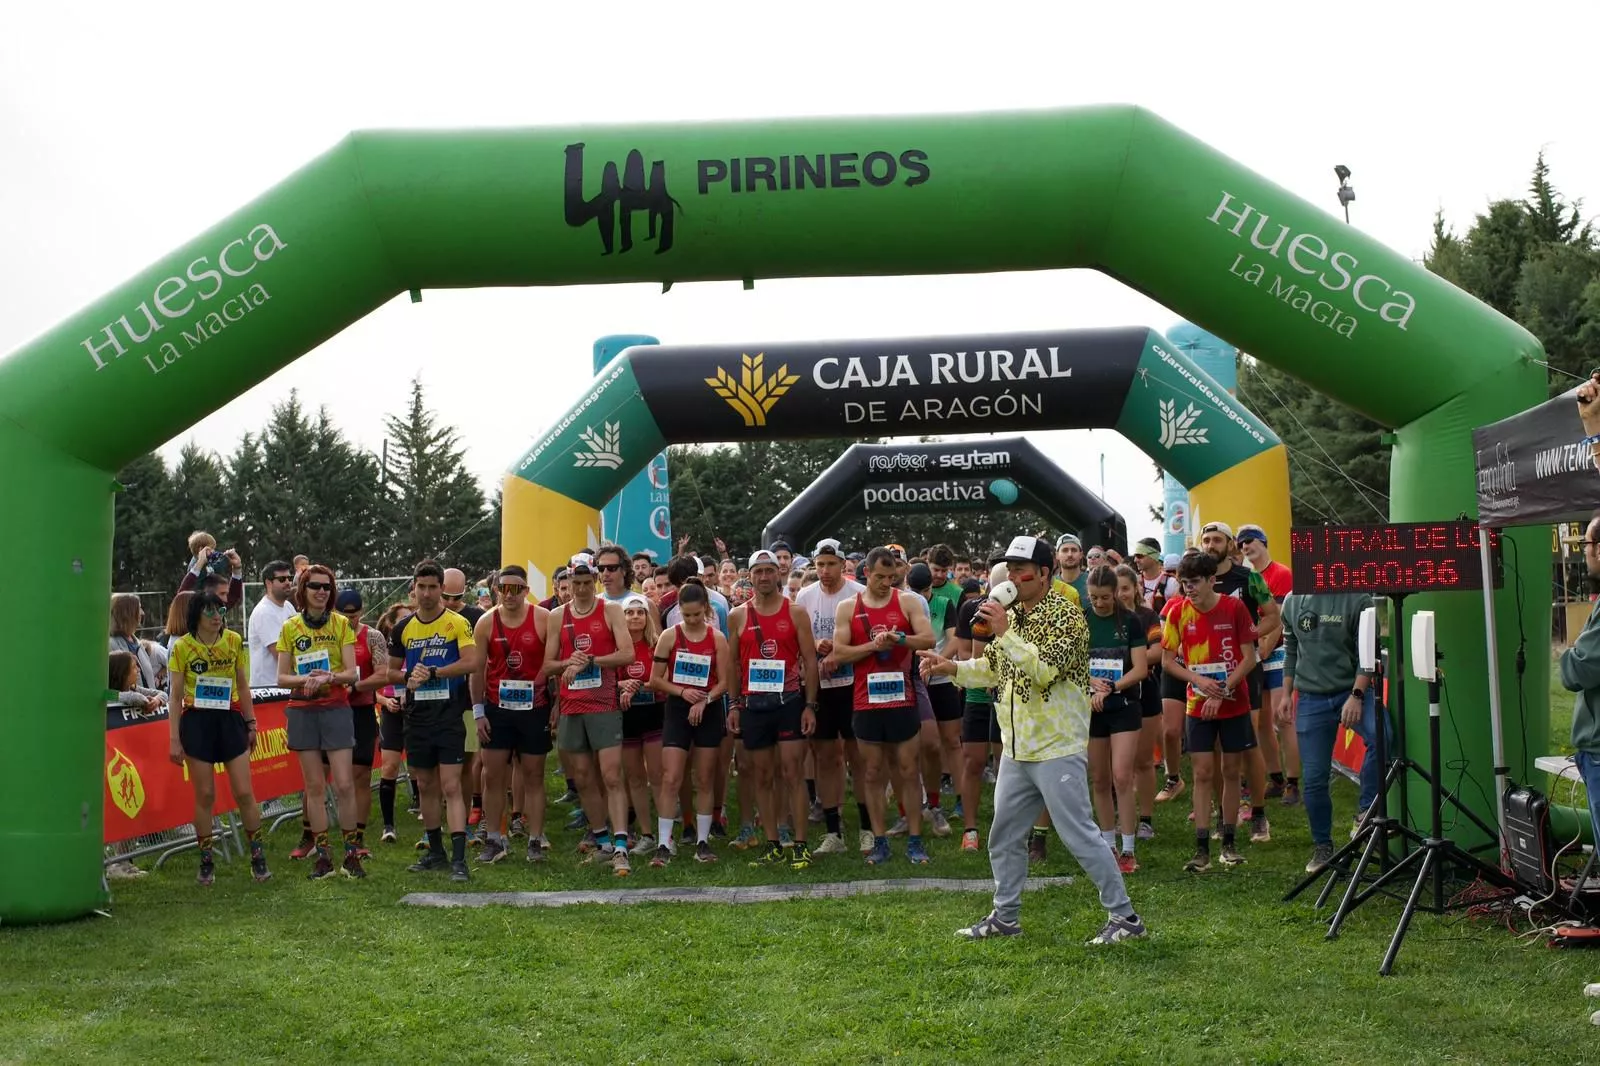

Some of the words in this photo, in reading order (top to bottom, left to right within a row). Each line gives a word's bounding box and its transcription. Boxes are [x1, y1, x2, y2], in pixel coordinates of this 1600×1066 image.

[697, 149, 931, 195] PIRINEOS
[812, 354, 920, 390] CAJA
[929, 347, 1073, 385] RURAL
[1152, 344, 1266, 445] cajaruraldearagon.es
[843, 401, 888, 424] DE
[899, 388, 1043, 421] ARAGÓN
[520, 366, 625, 470] cajaruraldearagon.es
[939, 449, 1011, 470] seytam
[863, 481, 986, 510] podoactiva
[1414, 527, 1446, 549] DE
[1312, 559, 1460, 589] 10:00:36
[1320, 614, 1343, 623] TRAIL
[211, 658, 233, 666] TRAIL
[682, 661, 703, 674] 450
[756, 669, 778, 680] 380
[202, 685, 224, 697] 246
[506, 689, 527, 699] 288
[875, 681, 897, 691] 440
